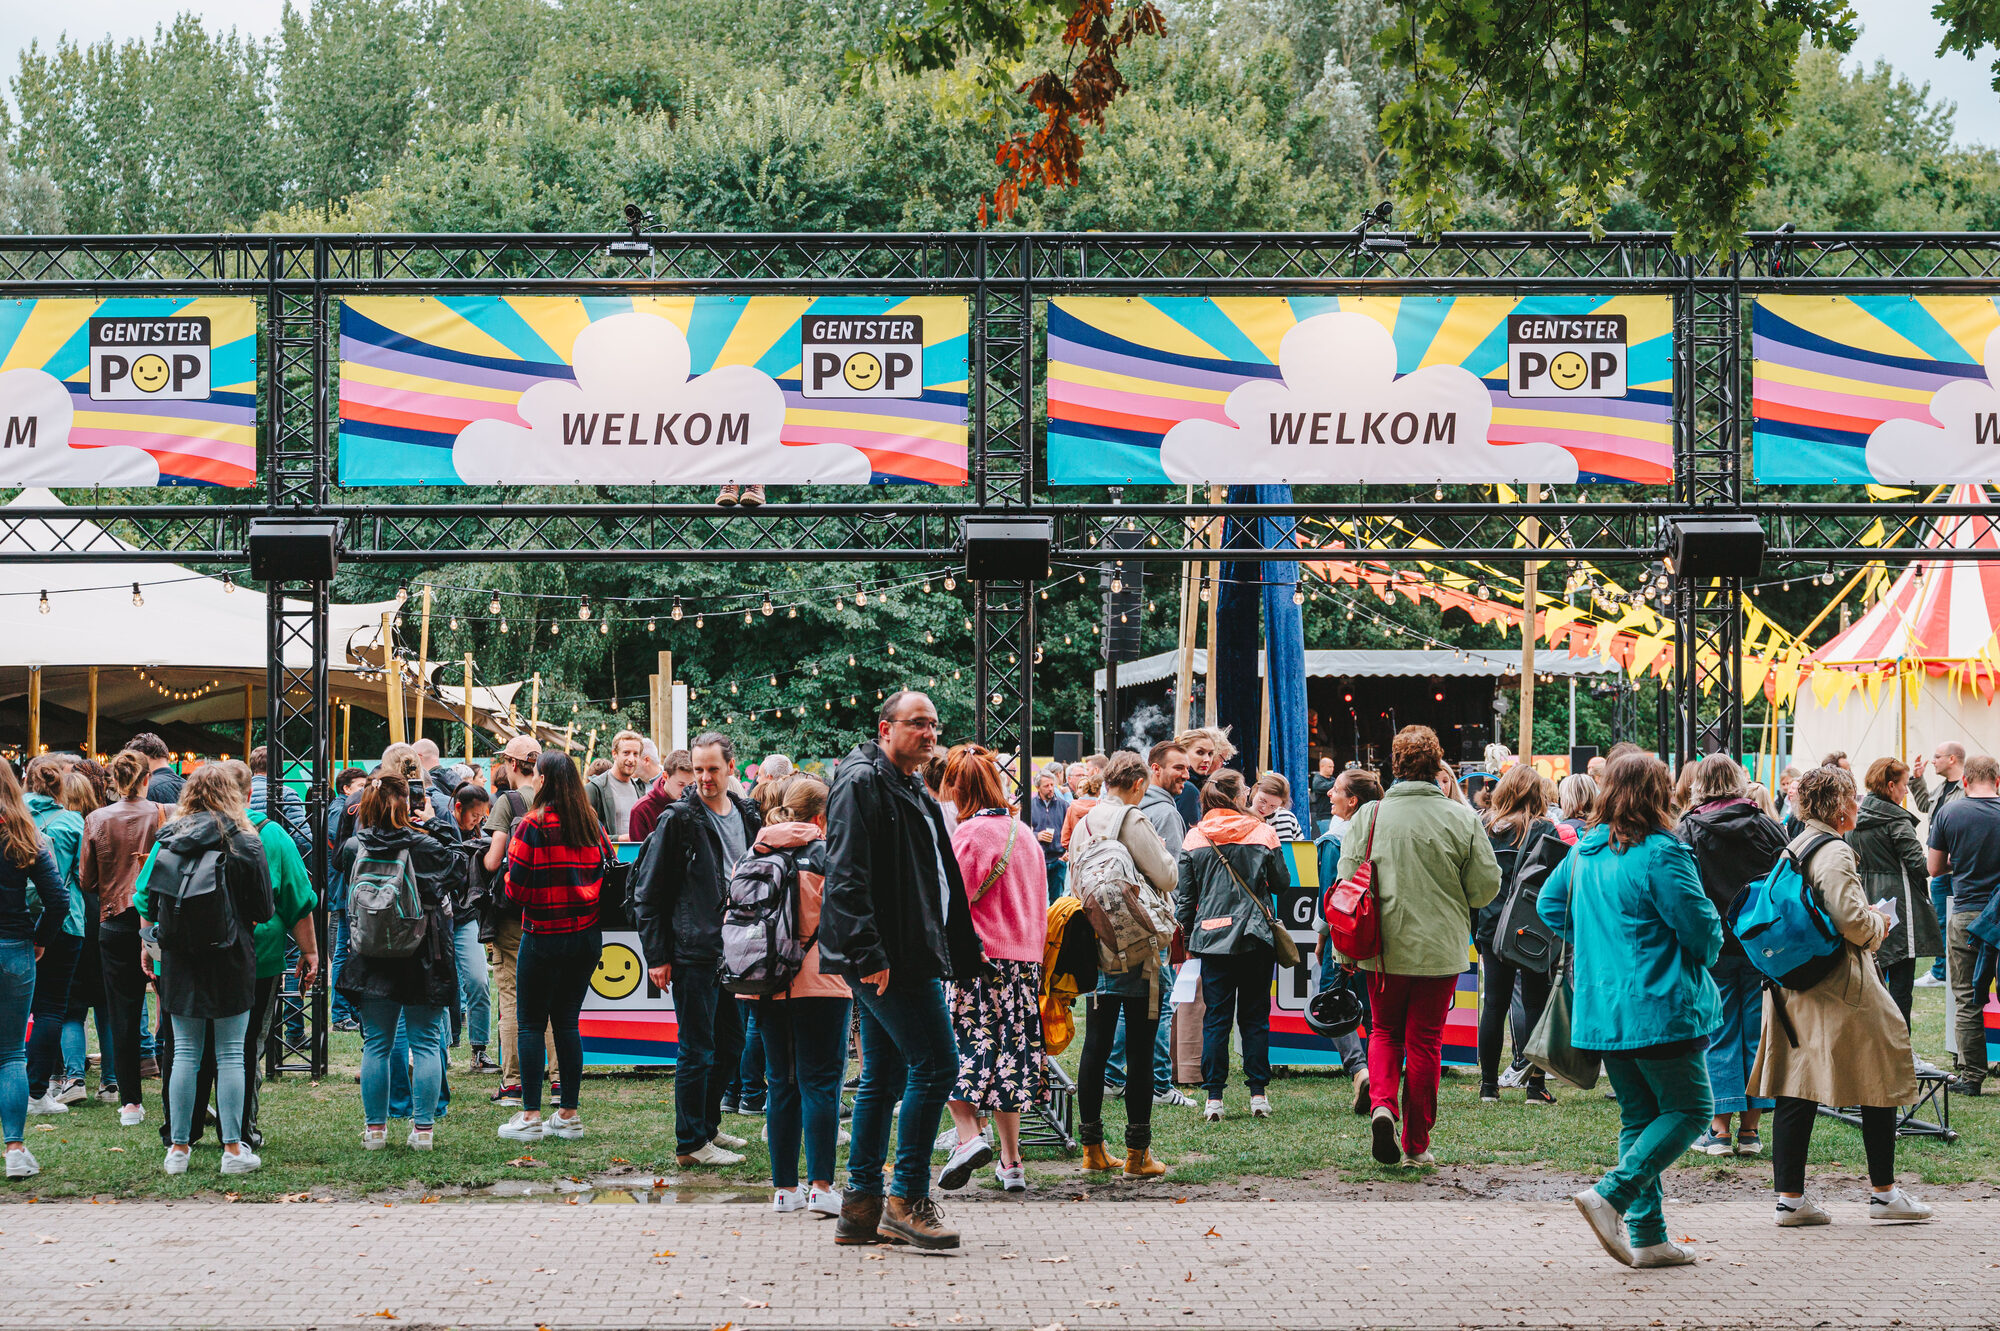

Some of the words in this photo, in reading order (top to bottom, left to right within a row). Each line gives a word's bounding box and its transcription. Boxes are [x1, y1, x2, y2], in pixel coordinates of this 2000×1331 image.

[99, 322, 202, 342] GENTSTER
[812, 320, 915, 340] GENTSTER
[1518, 320, 1619, 340] GENTSTER
[100, 353, 201, 393] POP
[813, 351, 914, 391] POP
[1519, 350, 1618, 390] POP
[562, 412, 750, 446] WELKOM
[1270, 411, 1457, 445] WELKOM
